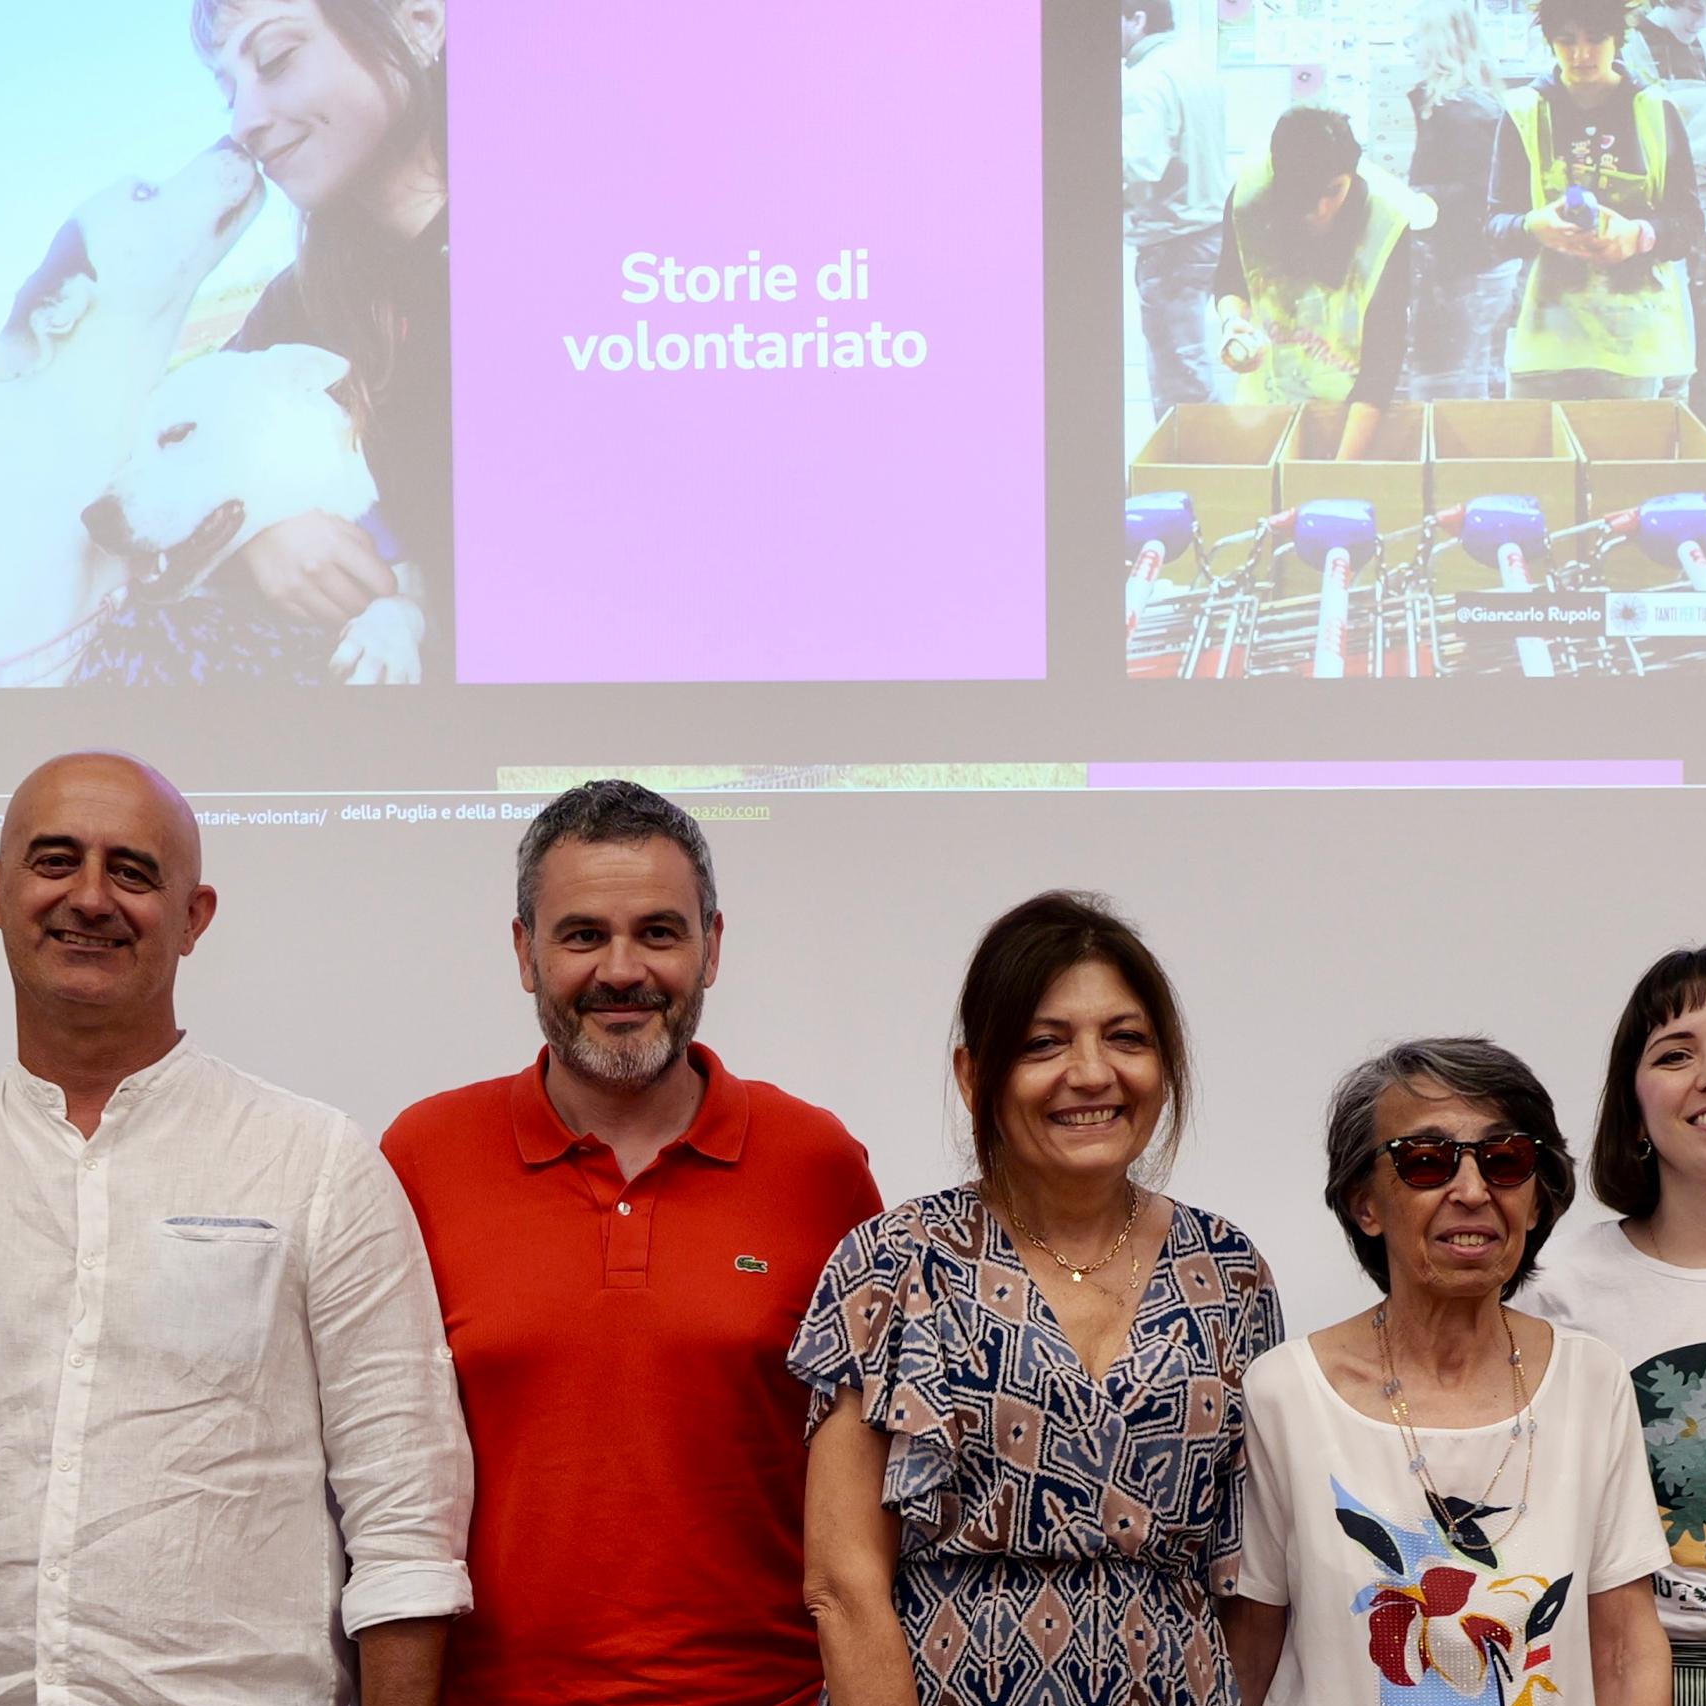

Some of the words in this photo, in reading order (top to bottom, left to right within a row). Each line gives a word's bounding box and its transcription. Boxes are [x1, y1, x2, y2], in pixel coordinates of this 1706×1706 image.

[621, 250, 797, 303] Storie
[816, 248, 869, 301] di
[562, 317, 928, 371] volontariato
[1457, 606, 1544, 623] @Giancarlo
[1548, 606, 1601, 625] Rupolo
[341, 804, 382, 820] della
[387, 804, 438, 824] Puglia
[442, 807, 453, 820] e
[455, 803, 496, 820] della
